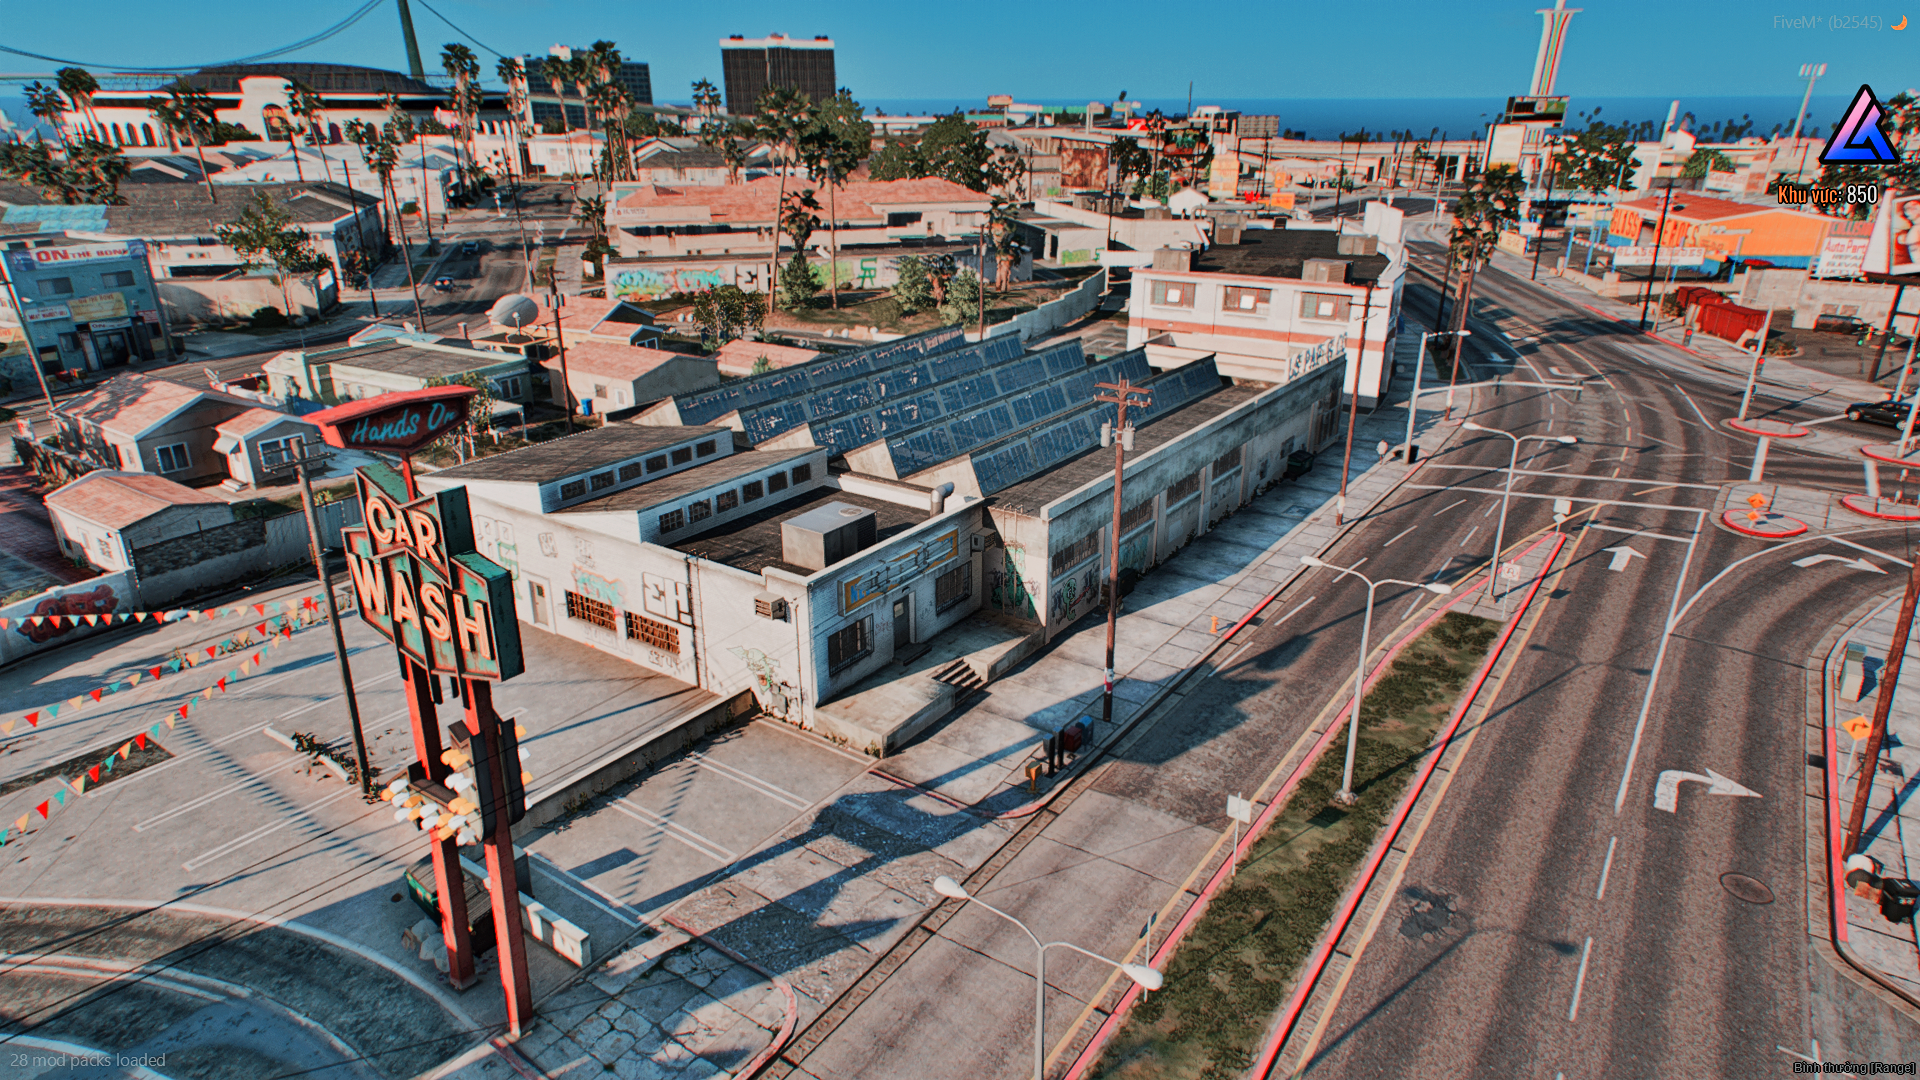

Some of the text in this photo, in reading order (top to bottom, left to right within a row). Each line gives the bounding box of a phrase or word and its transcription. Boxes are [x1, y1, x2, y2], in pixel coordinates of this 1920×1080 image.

[35, 249, 71, 263] ON
[69, 250, 92, 259] THE
[1824, 239, 1846, 253] Auto
[350, 402, 456, 443] Hands On
[365, 495, 444, 565] CAR
[347, 552, 494, 661] WASH
